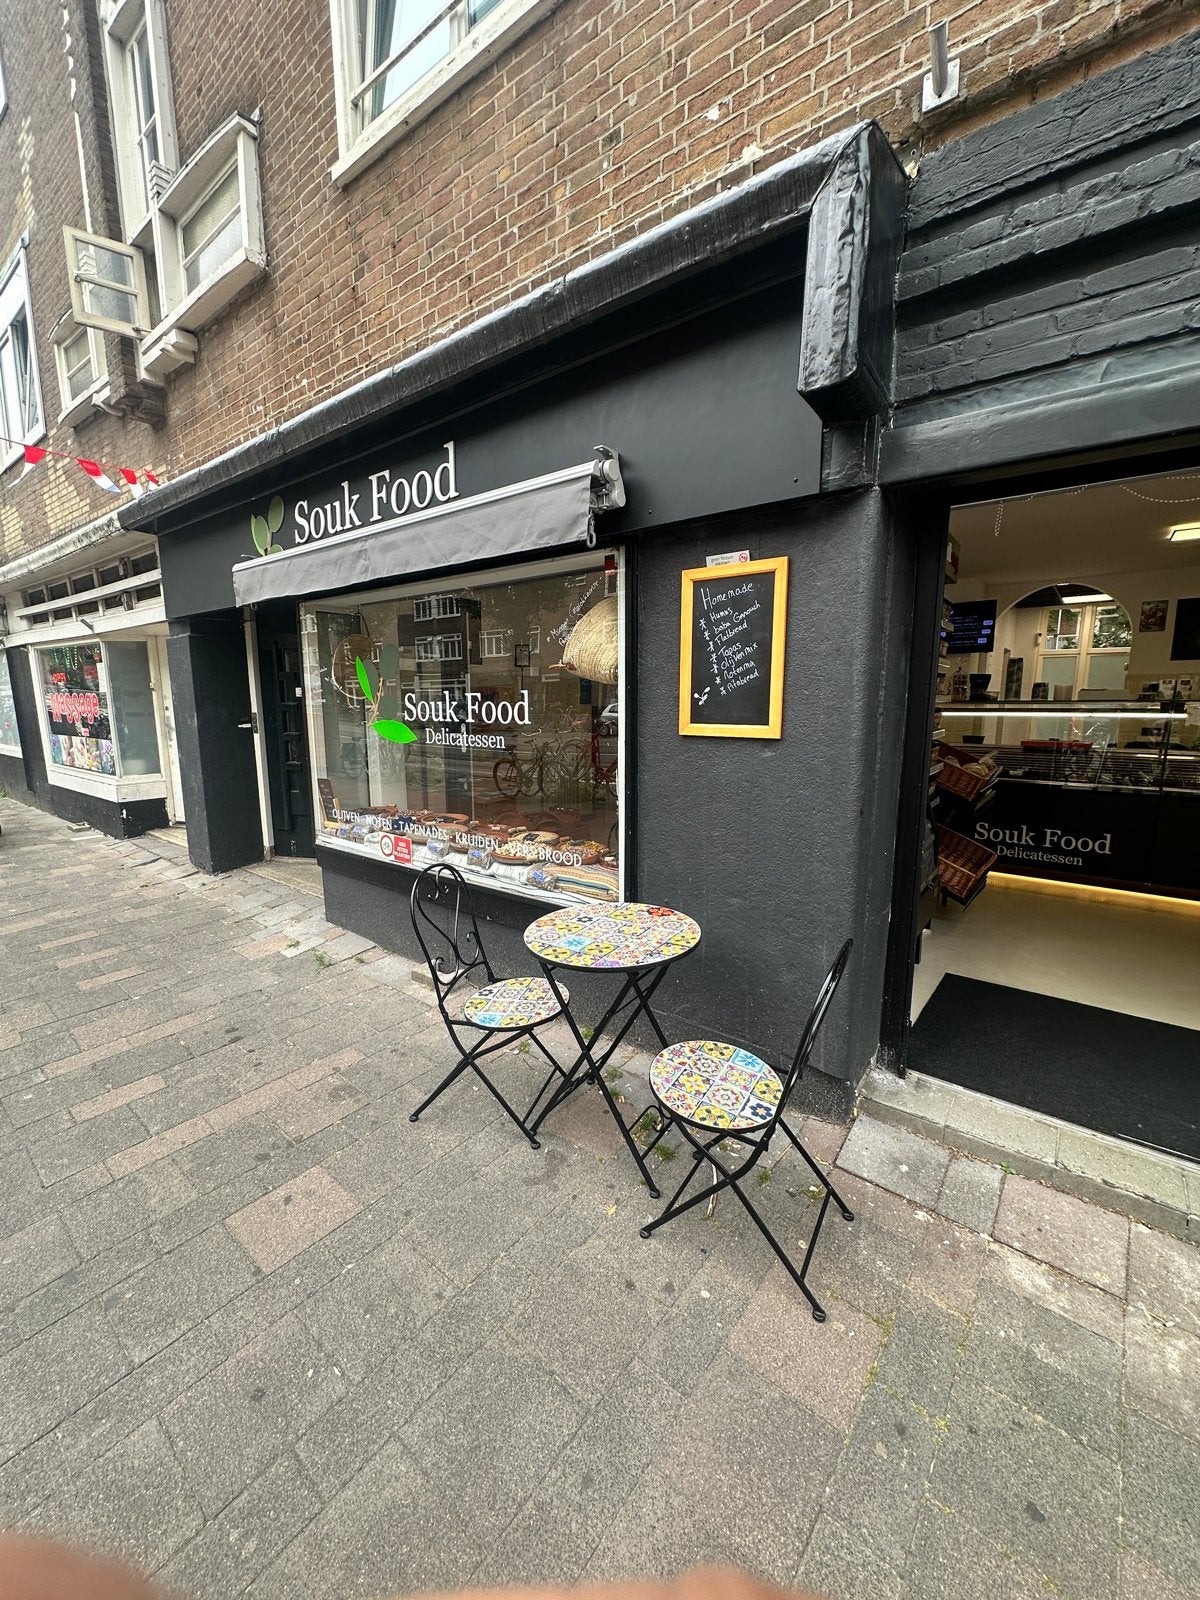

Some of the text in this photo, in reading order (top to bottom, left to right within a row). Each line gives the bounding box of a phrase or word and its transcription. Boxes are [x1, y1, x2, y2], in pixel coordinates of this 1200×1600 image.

[294, 440, 460, 544] Souk Food
[404, 689, 532, 725] Souk Food
[425, 727, 506, 749] Delicatessen
[332, 808, 361, 823] OLIJVEN
[365, 815, 393, 831] NOTEN
[398, 821, 449, 841] TAPENADES
[455, 831, 499, 852] KRUIDEN
[539, 847, 582, 868] BROOD
[974, 821, 1112, 855] Souk Food
[996, 845, 1083, 866] Delicatessen
